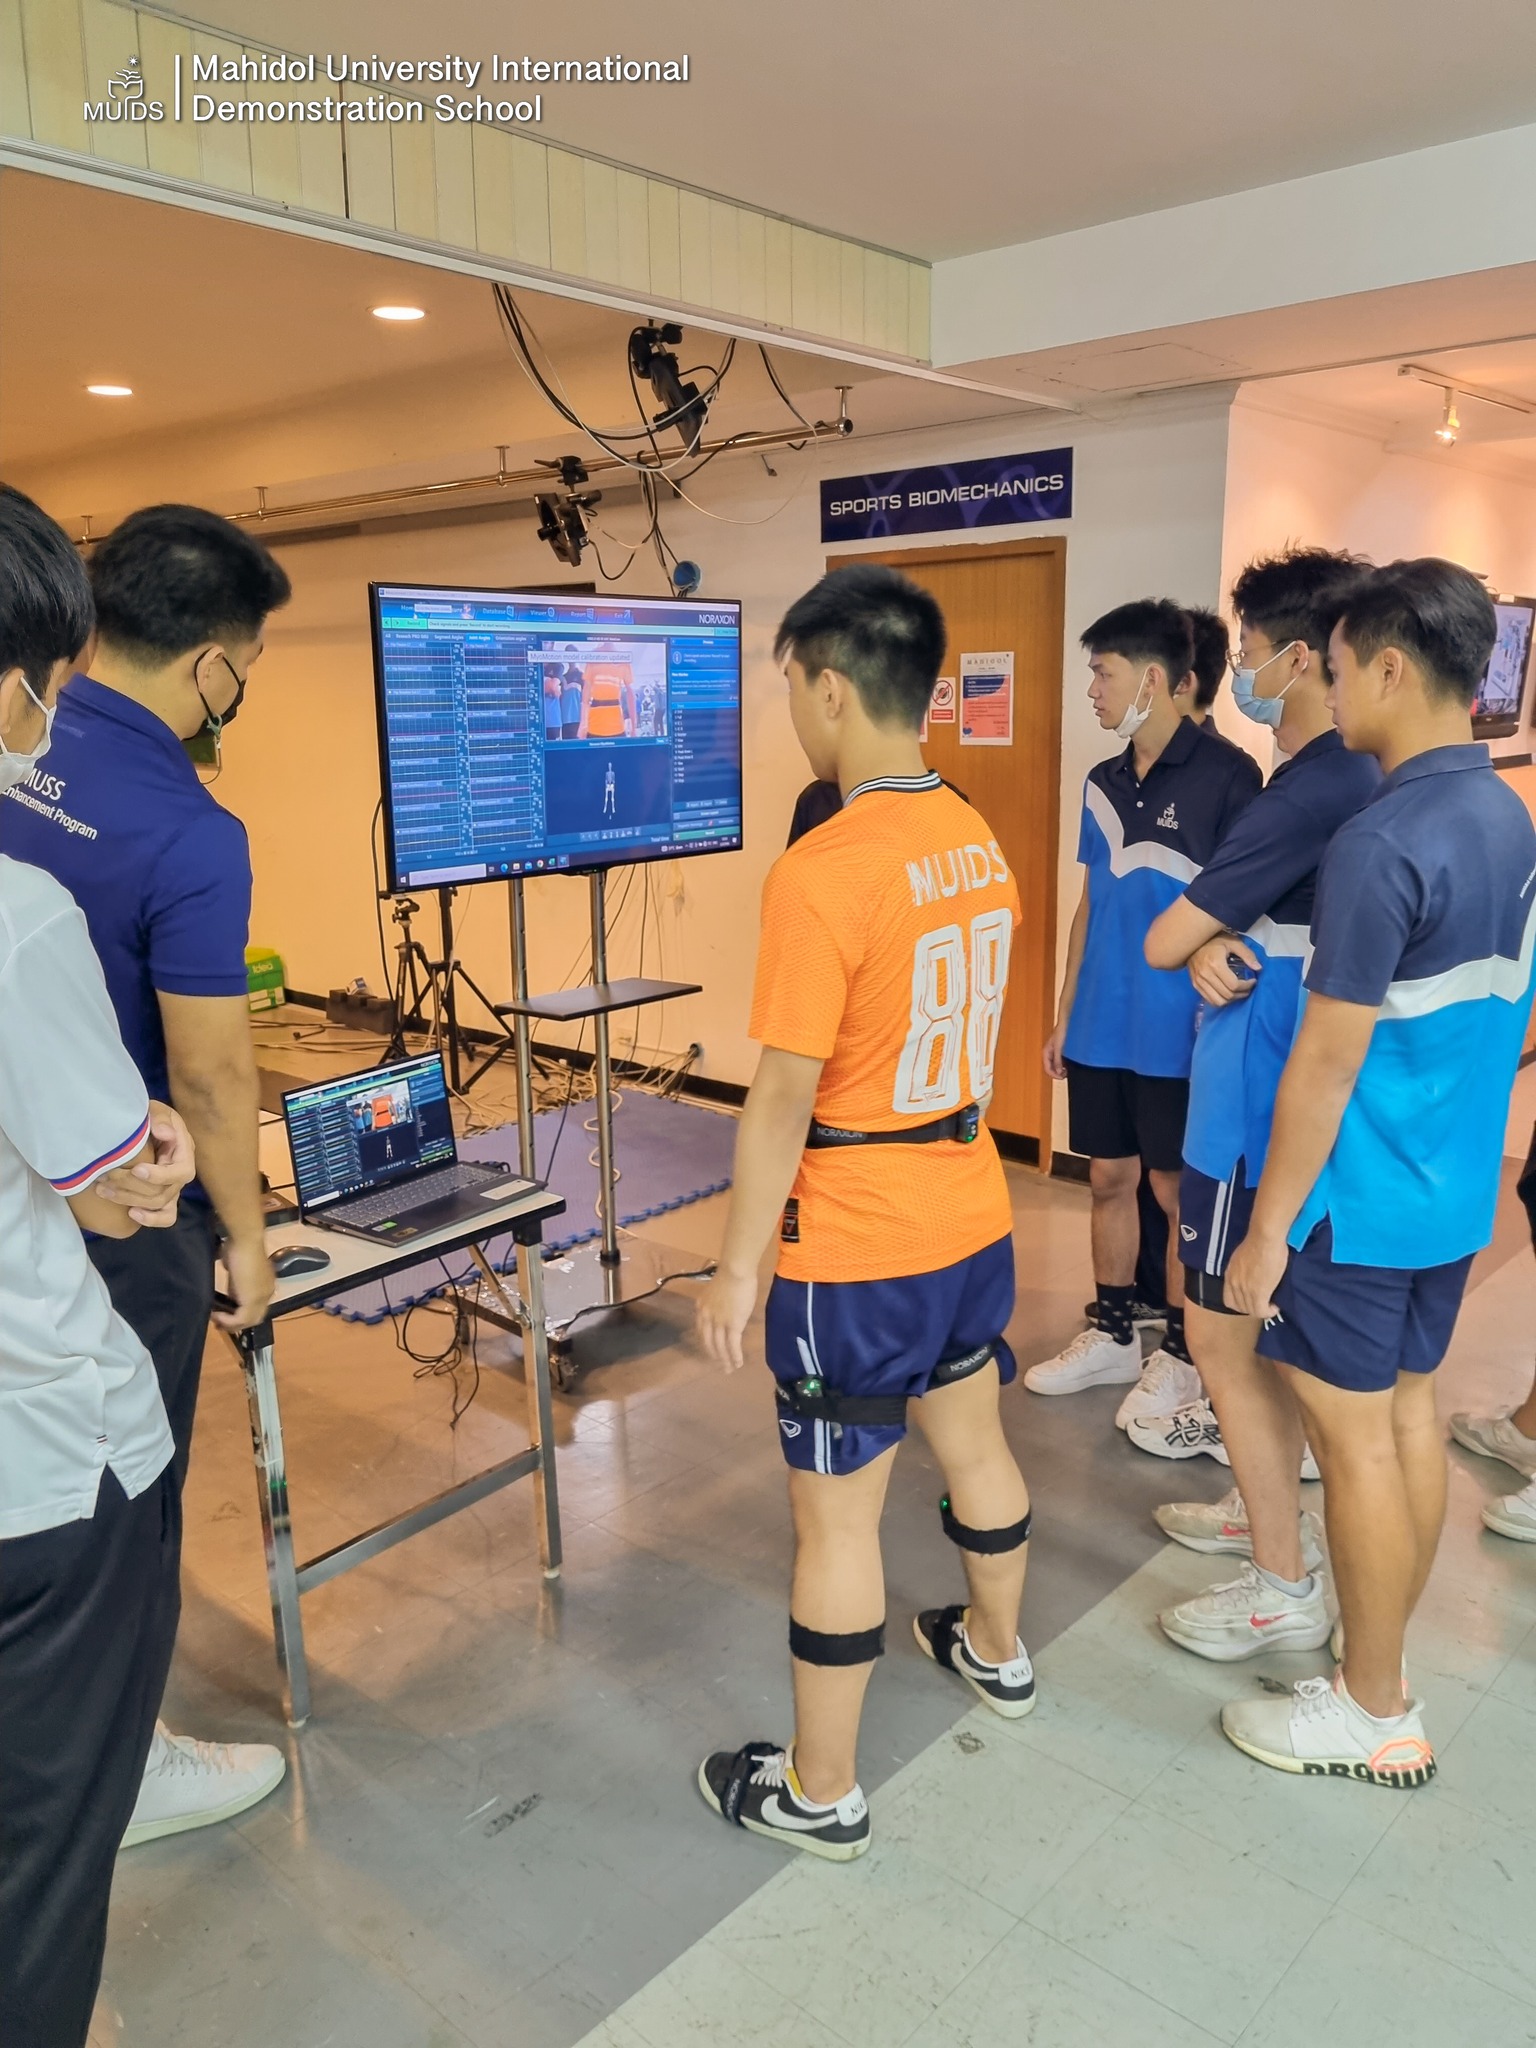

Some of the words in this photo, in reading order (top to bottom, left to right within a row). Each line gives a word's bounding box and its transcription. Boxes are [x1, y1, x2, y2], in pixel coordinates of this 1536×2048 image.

[830, 494, 902, 517] SPORTS
[908, 474, 1065, 508] BIOMECHANICS
[699, 614, 736, 625] NORAXON
[530, 653, 562, 661] MyoMotion
[53, 808, 98, 840] Program
[905, 839, 1008, 907] MUIDS
[893, 907, 1013, 1114] 88
[816, 1127, 864, 1138] NORAXON
[949, 1346, 988, 1372] NORAXON
